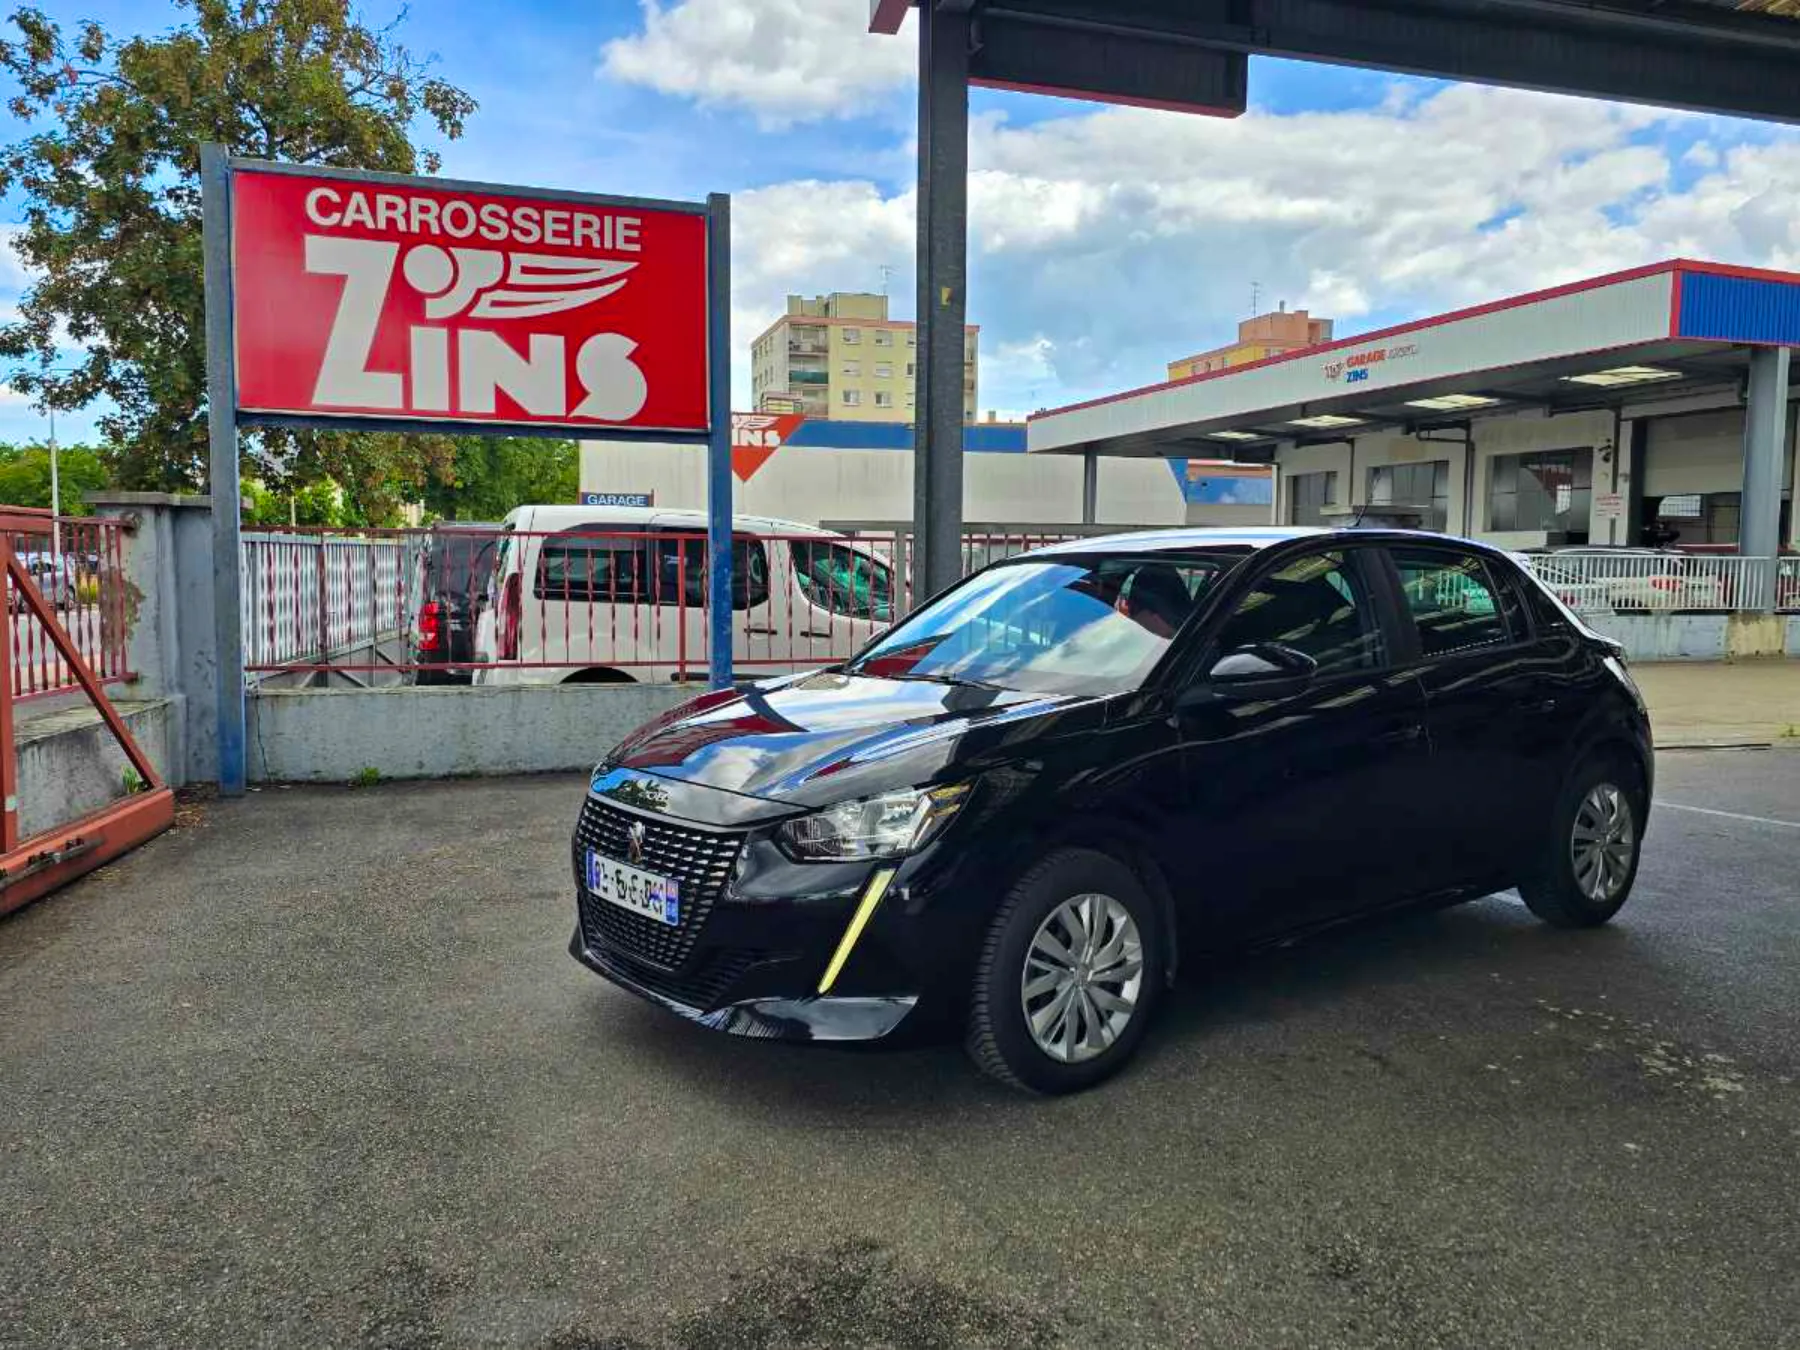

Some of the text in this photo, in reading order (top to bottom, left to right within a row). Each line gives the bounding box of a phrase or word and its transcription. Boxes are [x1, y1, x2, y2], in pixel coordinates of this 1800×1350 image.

[305, 187, 642, 252] CARROSSERIE
[304, 234, 648, 421] ZINS
[1346, 349, 1386, 367] GARAGE
[1346, 368, 1369, 383] ZINS
[731, 429, 781, 447] INS
[587, 494, 647, 506] GARAGE
